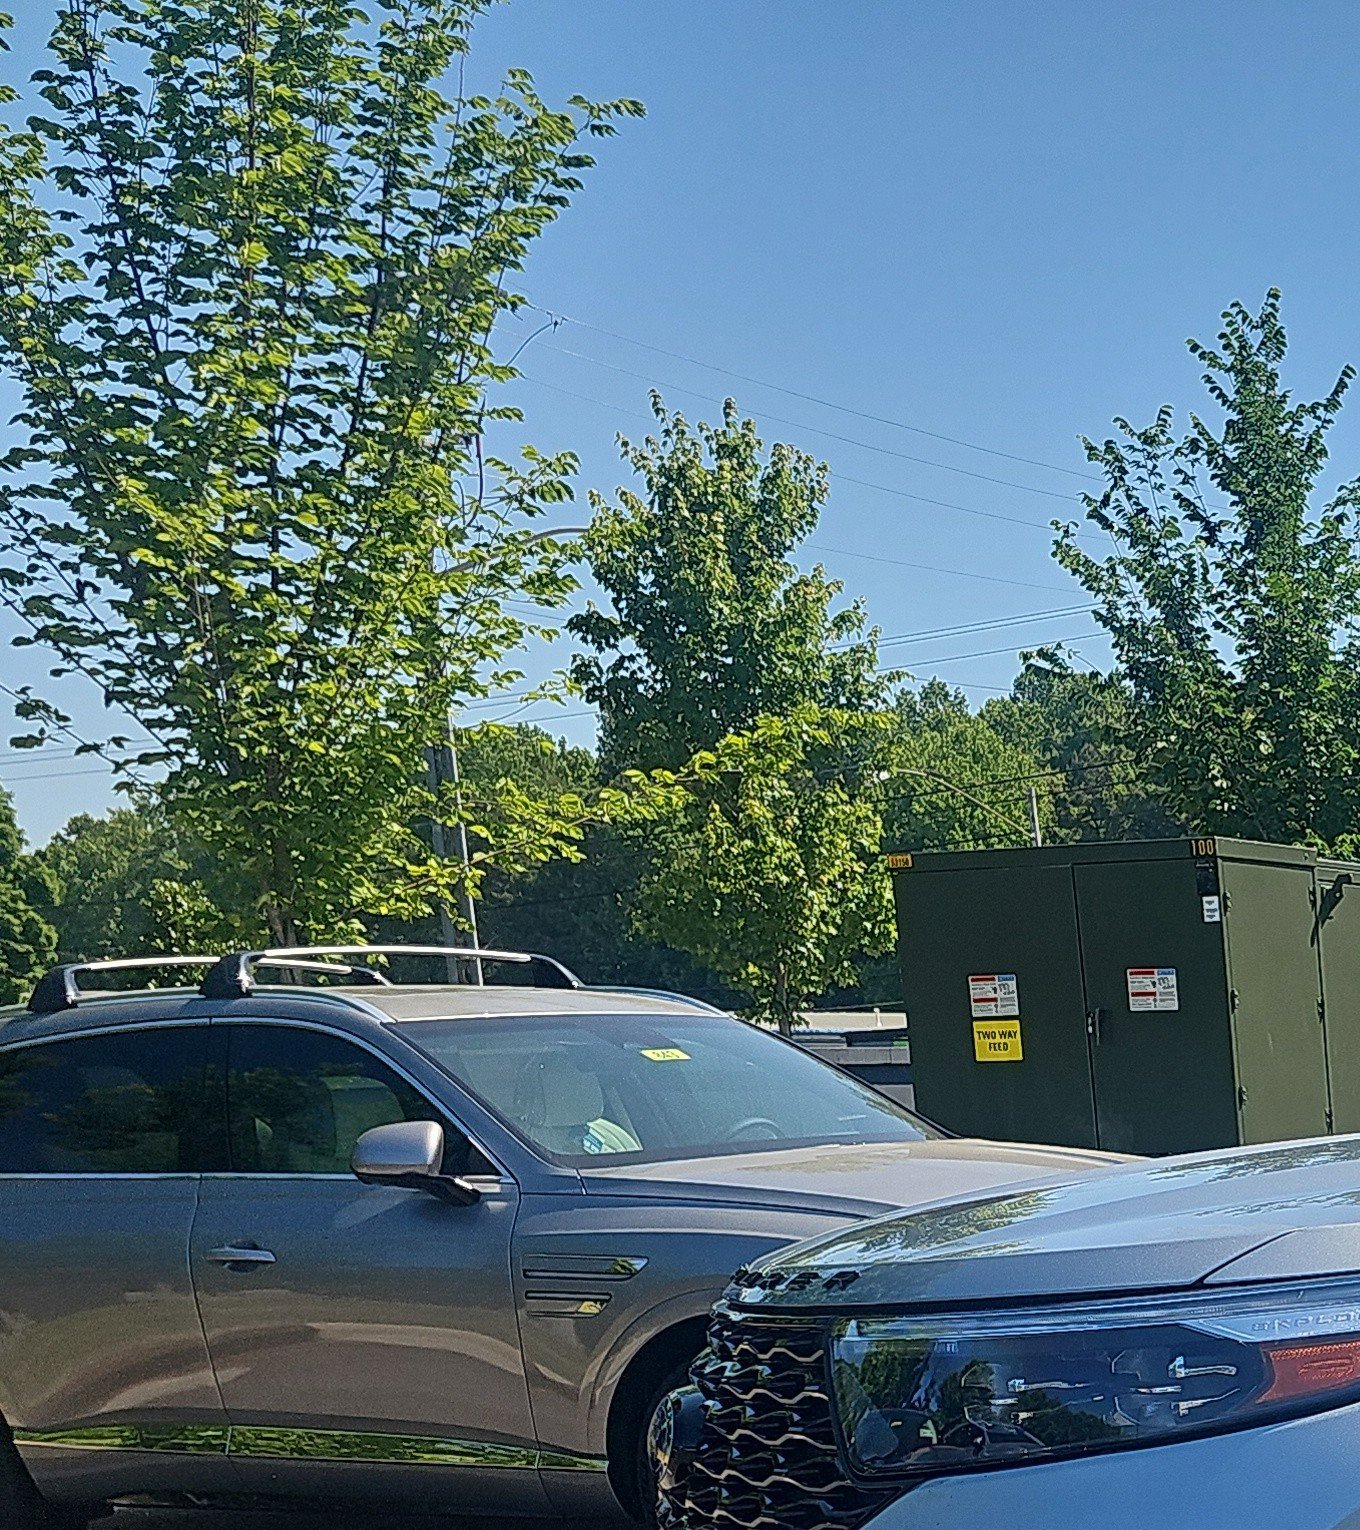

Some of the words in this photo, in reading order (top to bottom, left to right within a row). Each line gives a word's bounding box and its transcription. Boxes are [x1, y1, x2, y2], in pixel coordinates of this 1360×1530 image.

[1191, 839, 1214, 856] 100
[976, 1030, 997, 1040] TWO
[998, 1029, 1018, 1040] WAY
[988, 1041, 1009, 1052] FEED
